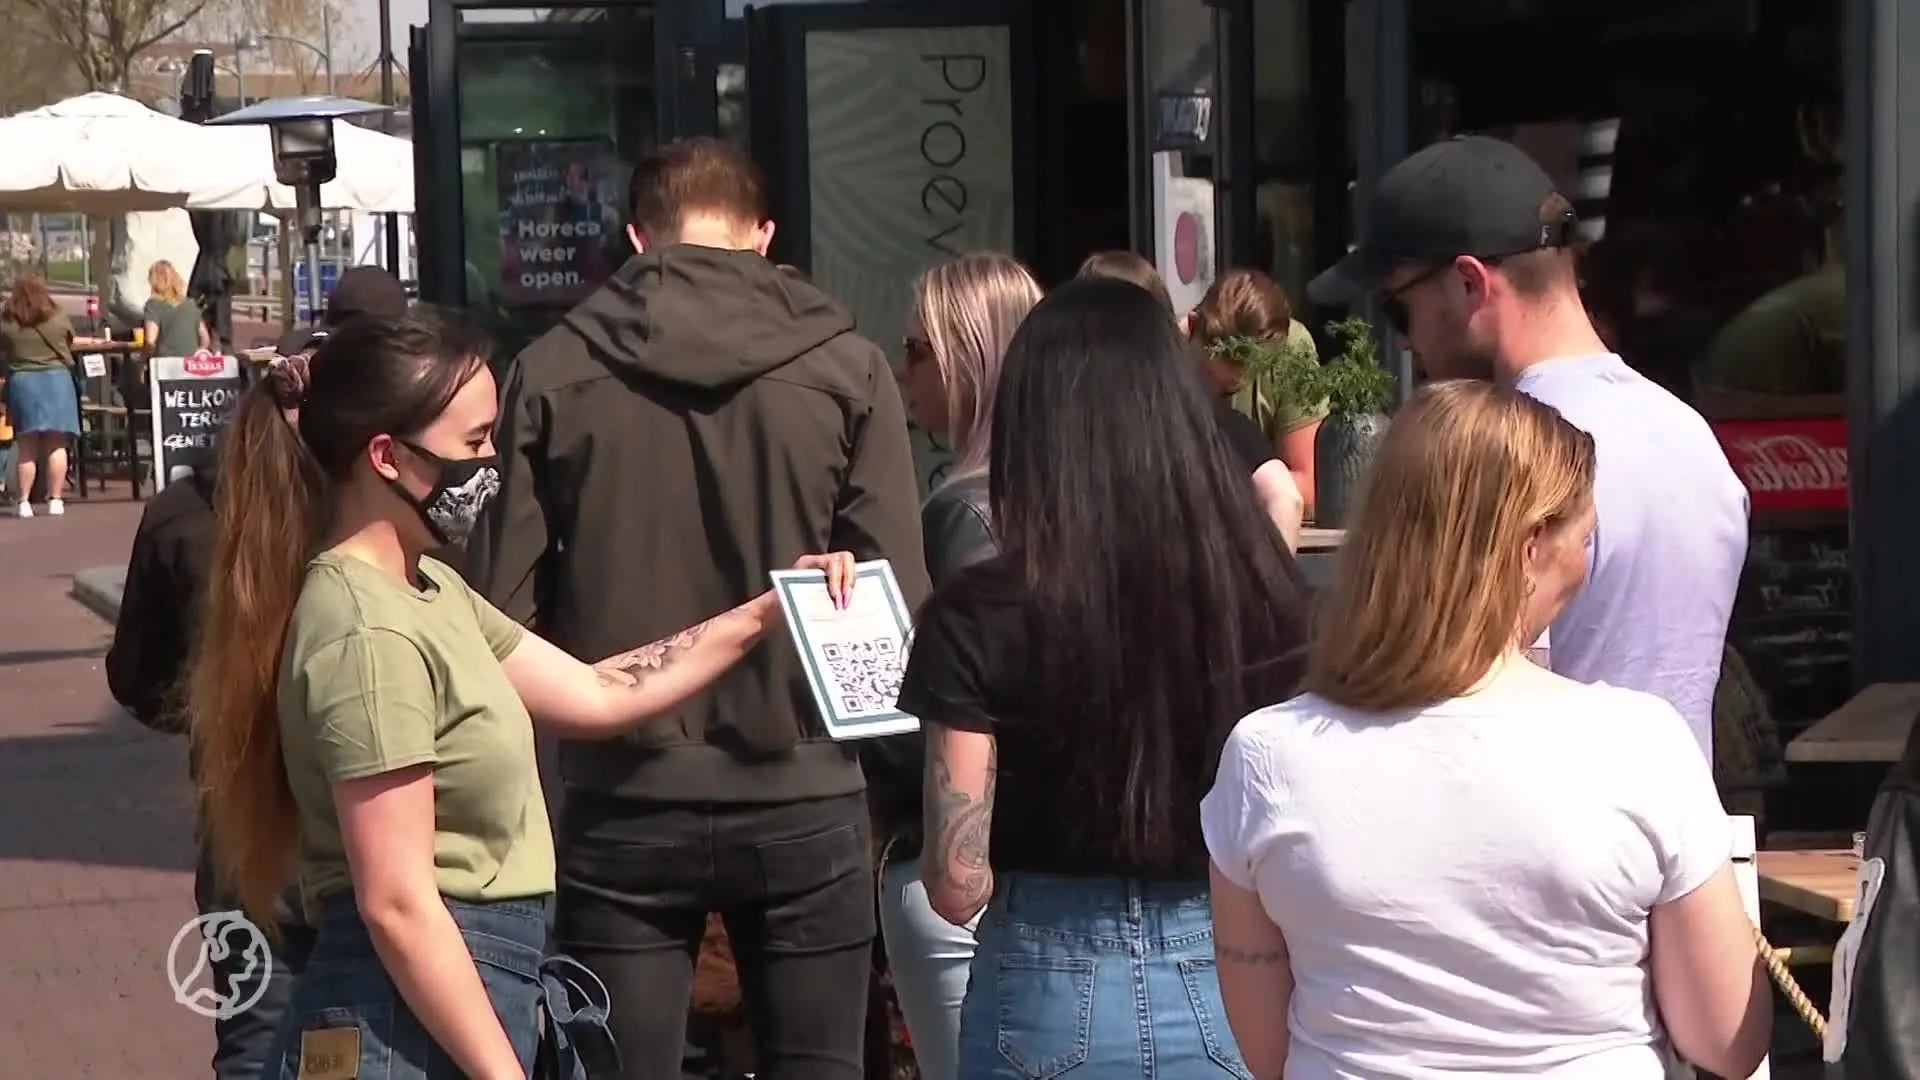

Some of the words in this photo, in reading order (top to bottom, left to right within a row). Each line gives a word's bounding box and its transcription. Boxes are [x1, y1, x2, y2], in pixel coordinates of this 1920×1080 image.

[518, 220, 600, 240] Horeca
[520, 247, 576, 263] weer
[520, 271, 585, 290] open.
